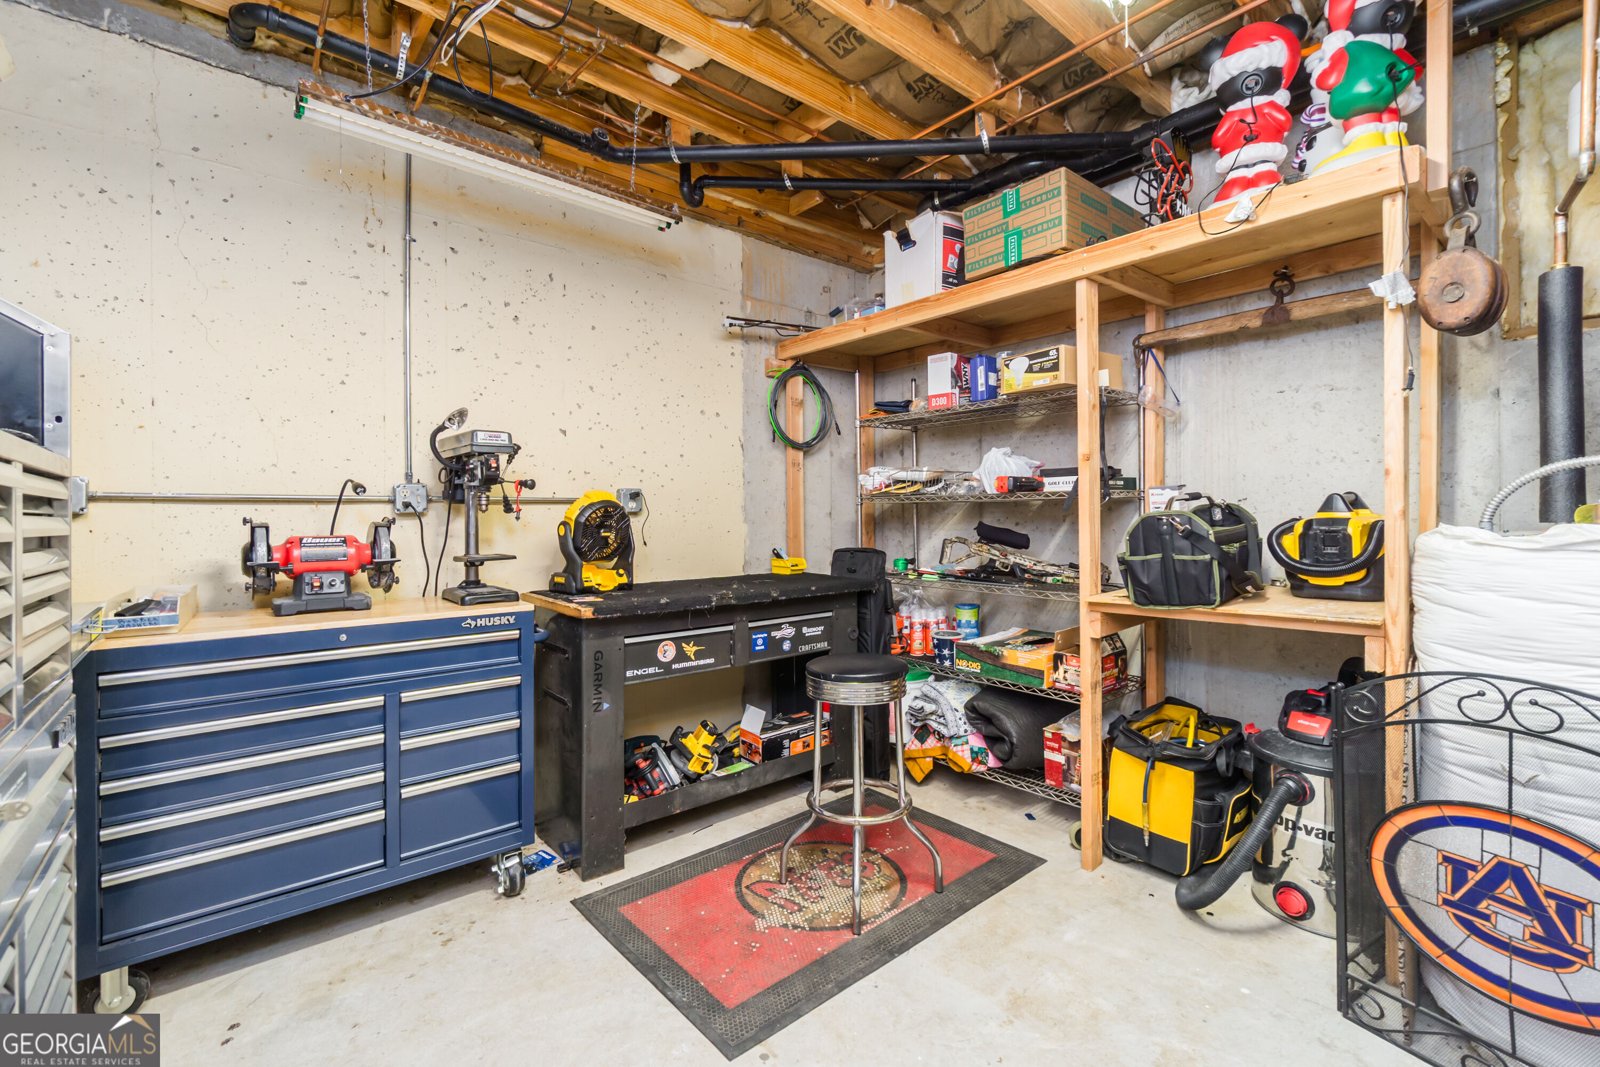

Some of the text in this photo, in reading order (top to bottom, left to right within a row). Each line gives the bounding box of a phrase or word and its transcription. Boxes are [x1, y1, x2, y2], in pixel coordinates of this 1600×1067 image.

[931, 397, 947, 407] D300
[476, 615, 516, 627] HUSKY
[798, 641, 828, 653] CRAFTSMAN
[625, 666, 664, 677] ENGEL
[593, 650, 604, 712] GARMIN
